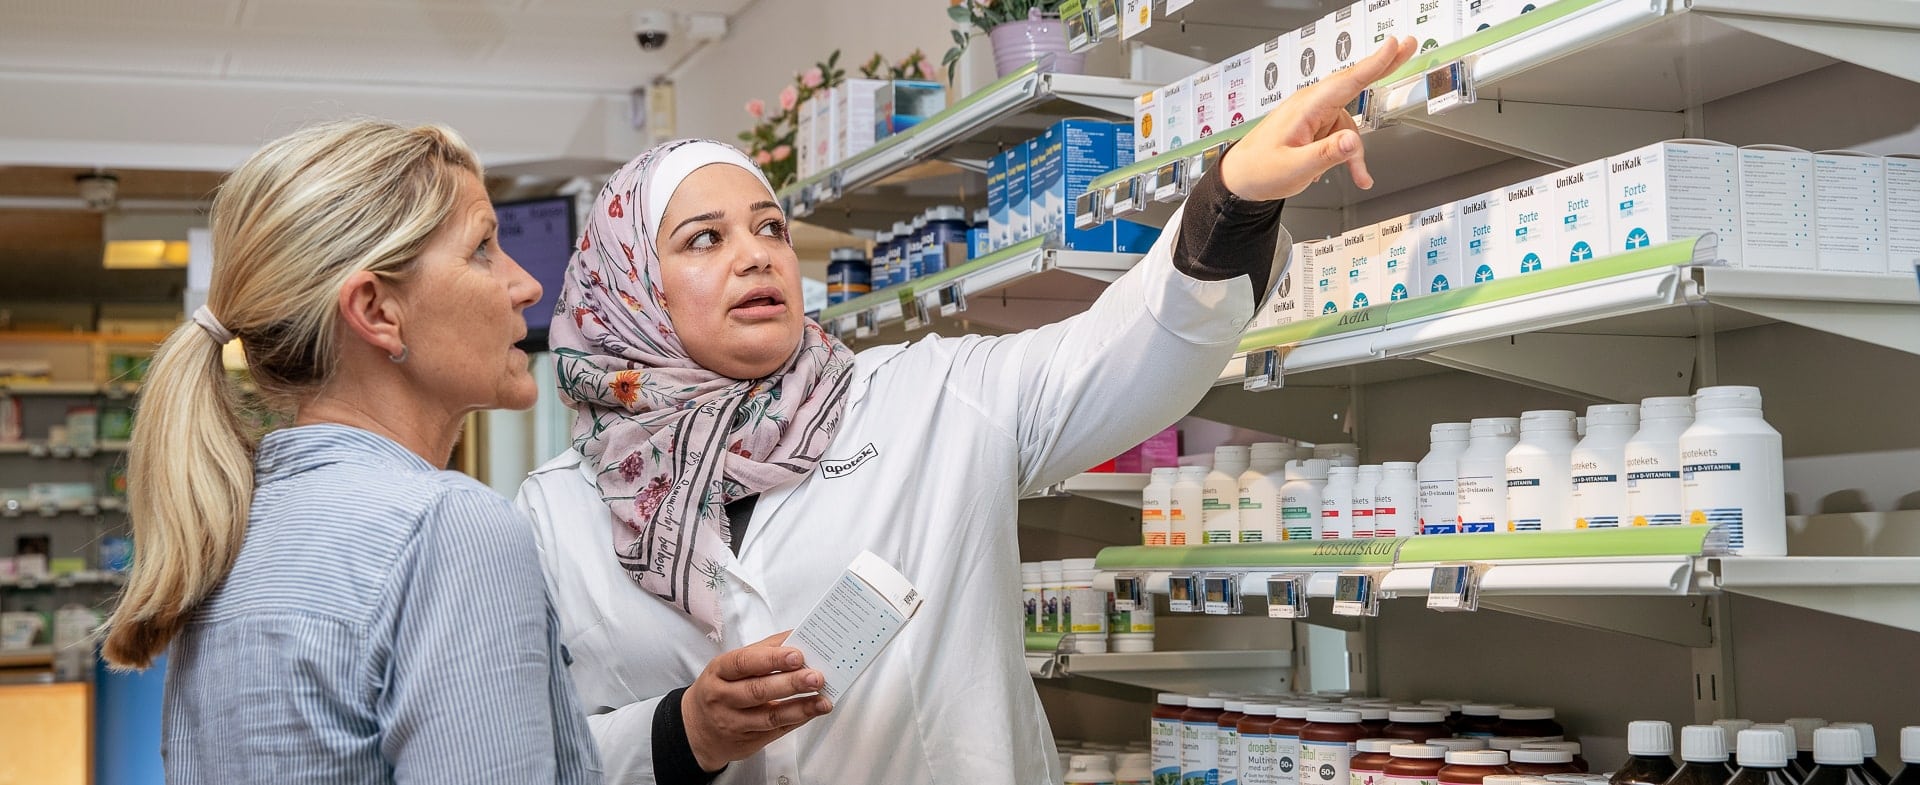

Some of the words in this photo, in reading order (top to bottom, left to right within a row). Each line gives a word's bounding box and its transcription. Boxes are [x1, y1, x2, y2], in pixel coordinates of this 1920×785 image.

[1420, 0, 1439, 14] Basic
[1377, 18, 1395, 32] Basic
[1224, 58, 1242, 72] UniKalk
[1230, 78, 1244, 89] Extra
[1164, 84, 1181, 98] UniKalk
[1200, 91, 1213, 102] Extra
[1260, 92, 1282, 106] UniKalk
[1138, 140, 1156, 152] UniKalk
[1612, 155, 1642, 174] UniKalk
[1556, 172, 1584, 188] UniKalk
[1508, 186, 1534, 202] UniKalk
[1624, 183, 1647, 198] Forte
[1463, 200, 1487, 215] UniKalk
[1568, 198, 1589, 212] Forte
[1421, 212, 1444, 226] UniKalk
[1519, 211, 1539, 224] Forte
[1381, 222, 1403, 237] UniKalk
[1473, 224, 1491, 237] Forte
[1344, 234, 1365, 247] UniKalk
[1430, 235, 1448, 248] Forte
[1314, 244, 1334, 257] UniKalk
[1390, 246, 1406, 258] Forte
[1352, 256, 1368, 268] Forte
[1322, 266, 1337, 277] Forte
[1274, 300, 1294, 314] UniKalk
[825, 448, 874, 475] apotek
